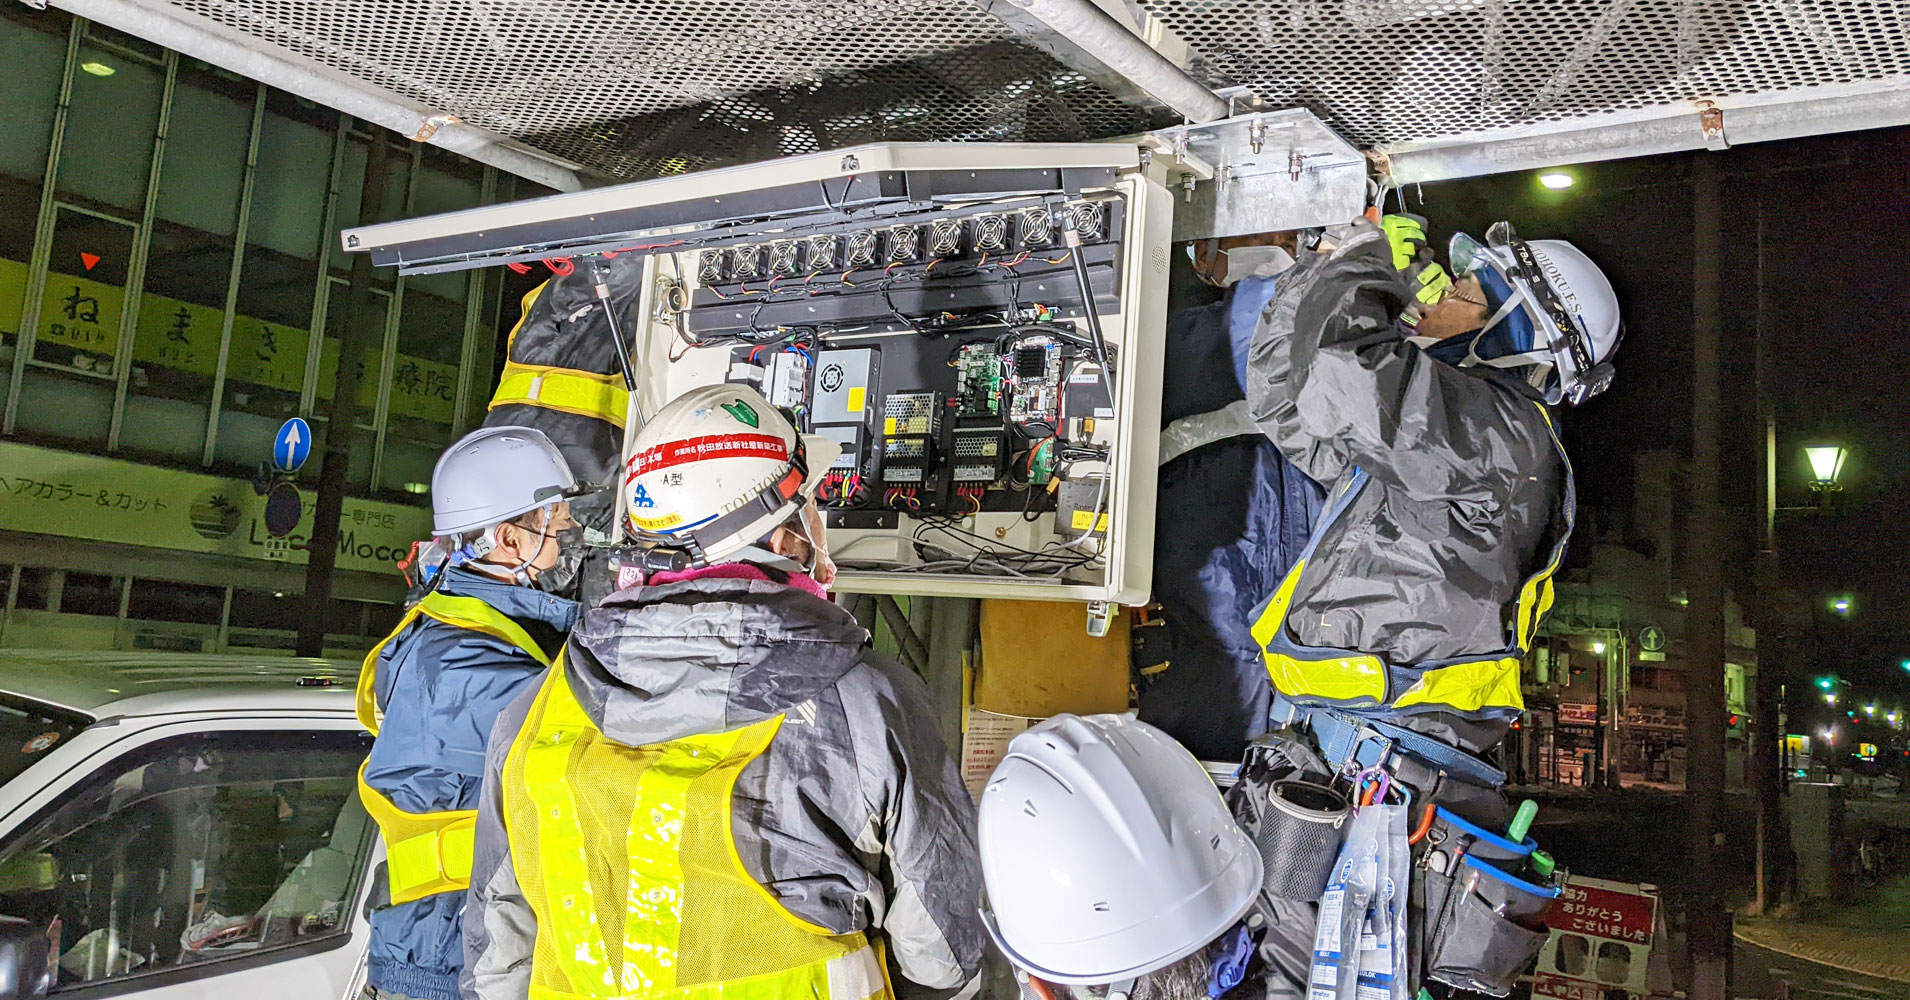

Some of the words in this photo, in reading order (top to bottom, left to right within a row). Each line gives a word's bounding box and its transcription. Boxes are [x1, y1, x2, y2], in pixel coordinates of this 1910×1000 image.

[662, 472, 685, 487] A型
[1562, 901, 1623, 922] ありがとう
[1572, 917, 1646, 942] ございました
